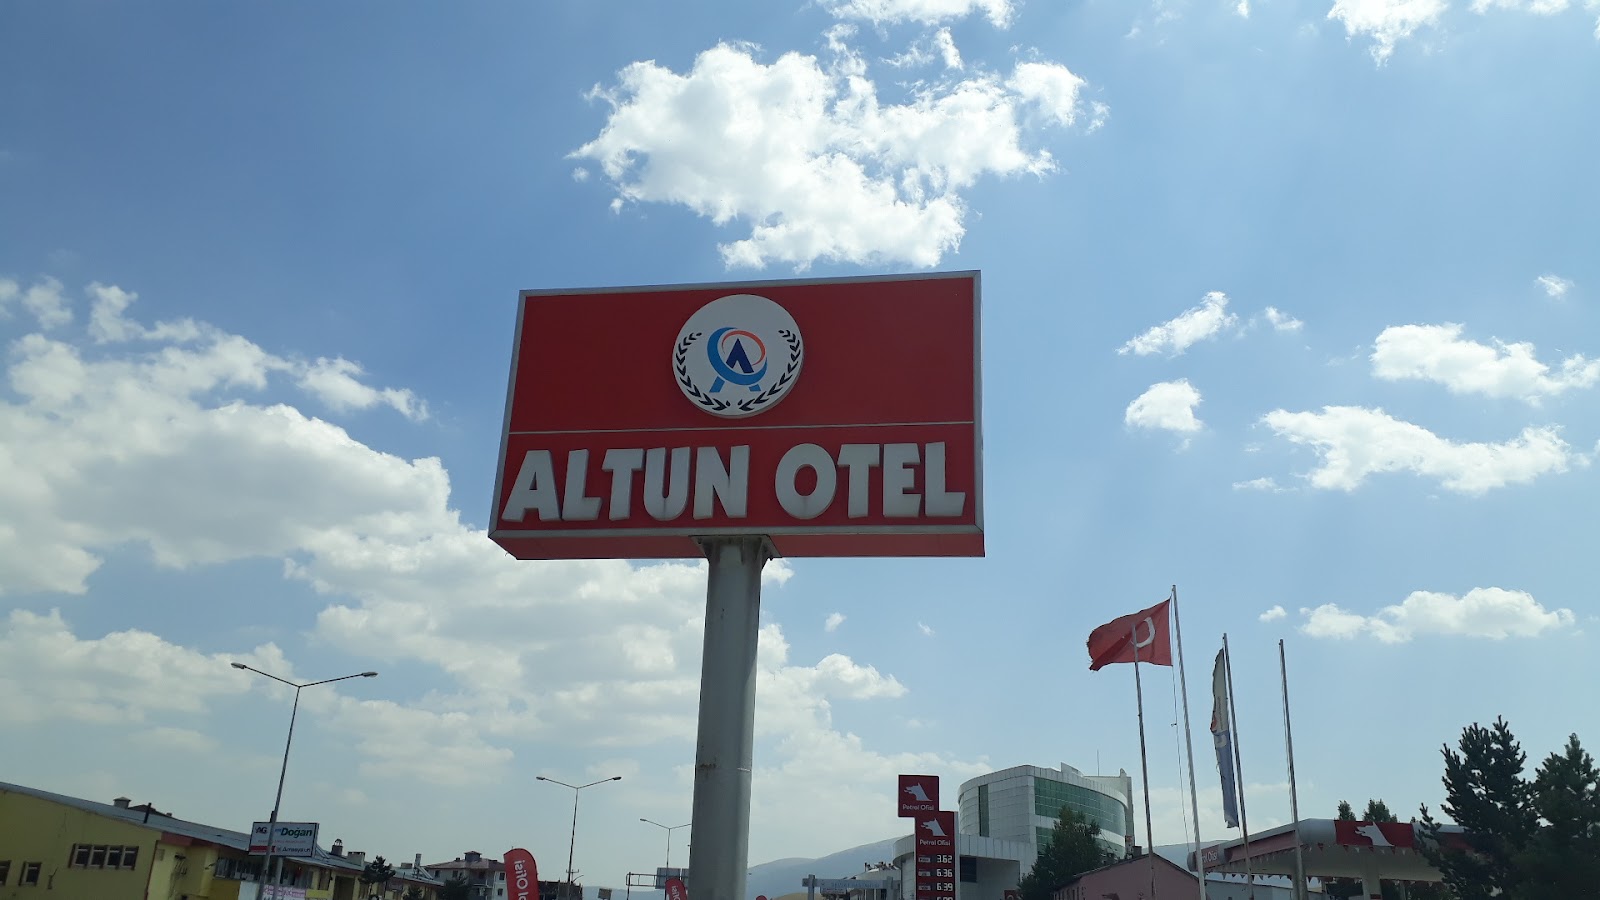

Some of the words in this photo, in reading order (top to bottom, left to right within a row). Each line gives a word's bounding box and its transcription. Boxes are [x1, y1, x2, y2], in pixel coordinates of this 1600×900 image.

[502, 445, 750, 521] ALTUN
[775, 441, 966, 520] OTEL
[281, 826, 313, 839] Doğan
[936, 854, 953, 864] 3.62
[936, 868, 953, 878] 6.36
[936, 882, 953, 892] 6.39
